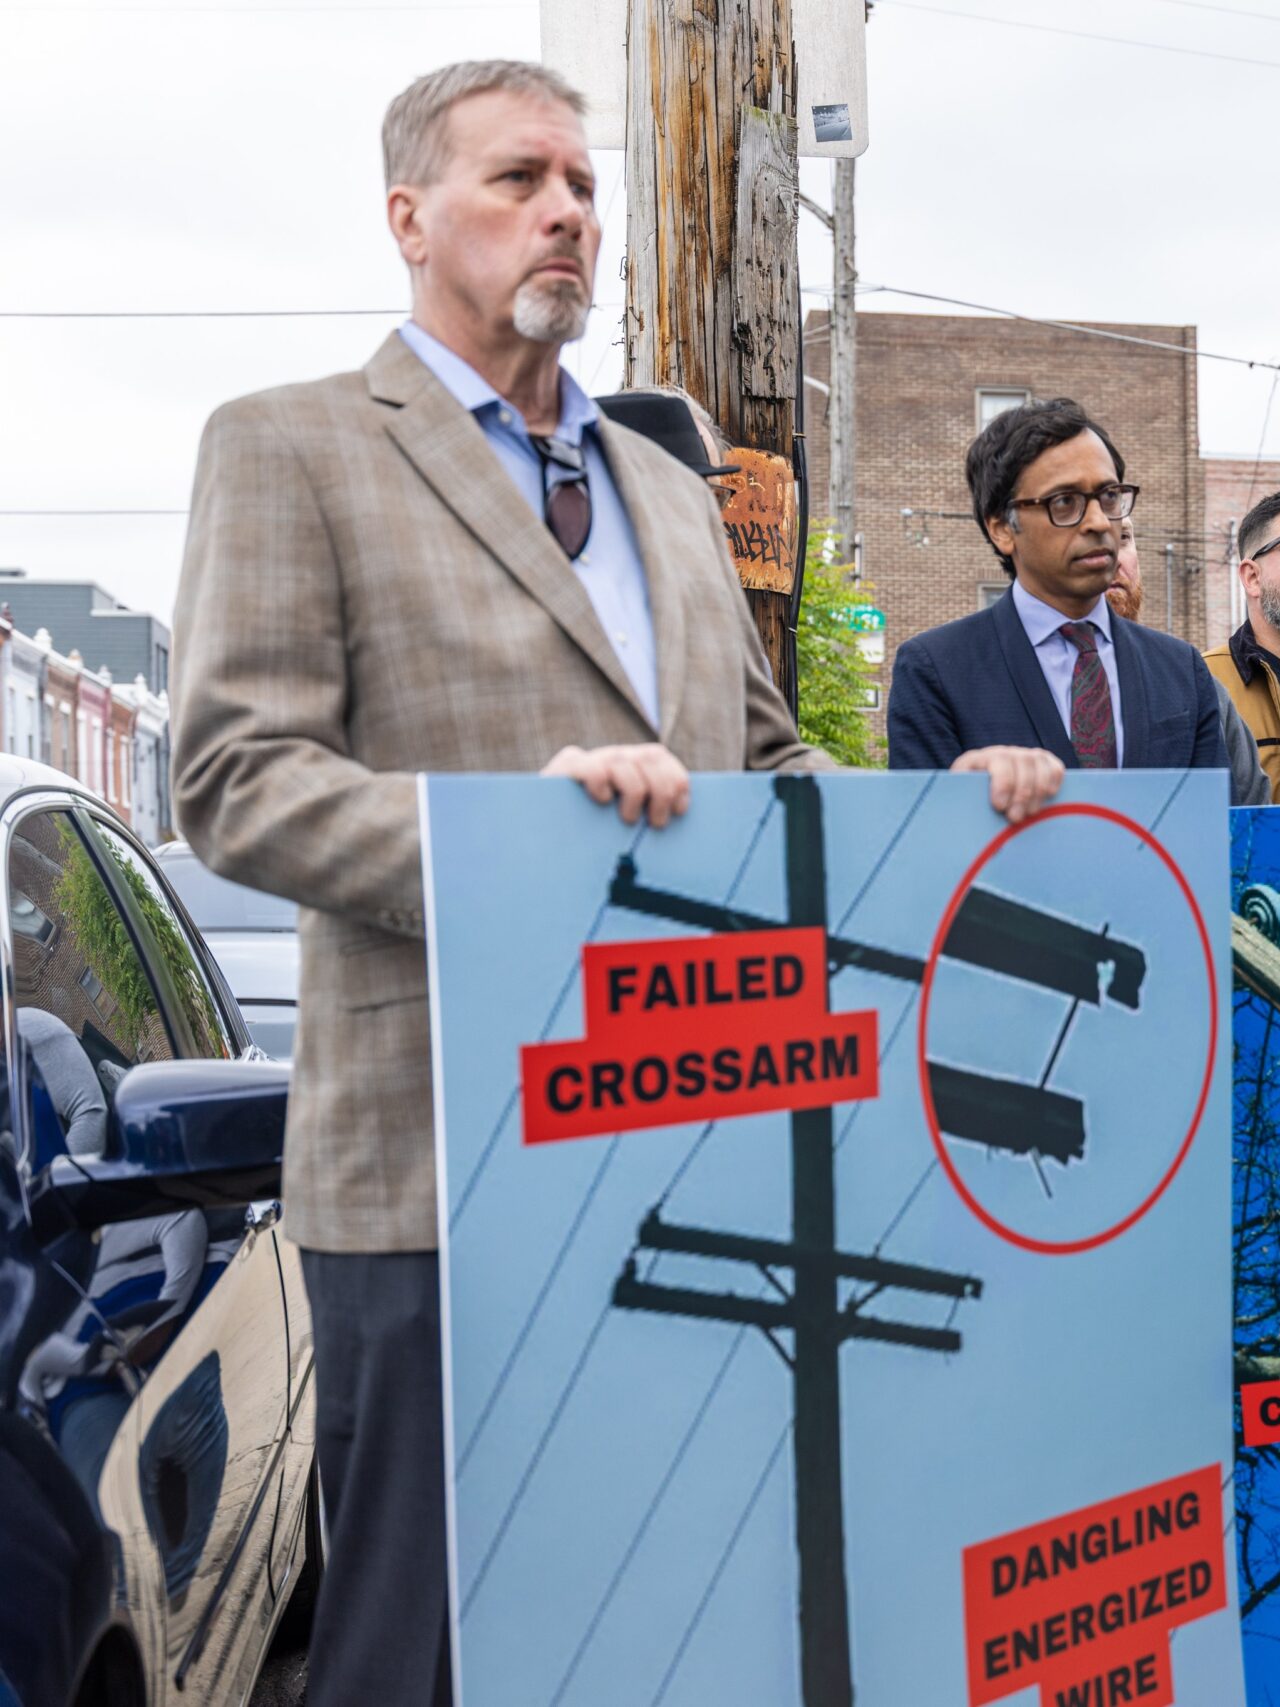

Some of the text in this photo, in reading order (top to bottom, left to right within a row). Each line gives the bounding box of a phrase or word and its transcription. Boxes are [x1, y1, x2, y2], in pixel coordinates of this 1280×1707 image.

[607, 954, 805, 1014] FAILED
[545, 1034, 861, 1115] CROSSARM
[991, 1491, 1200, 1598] DANGLING
[983, 1560, 1212, 1680] ENERGIZED
